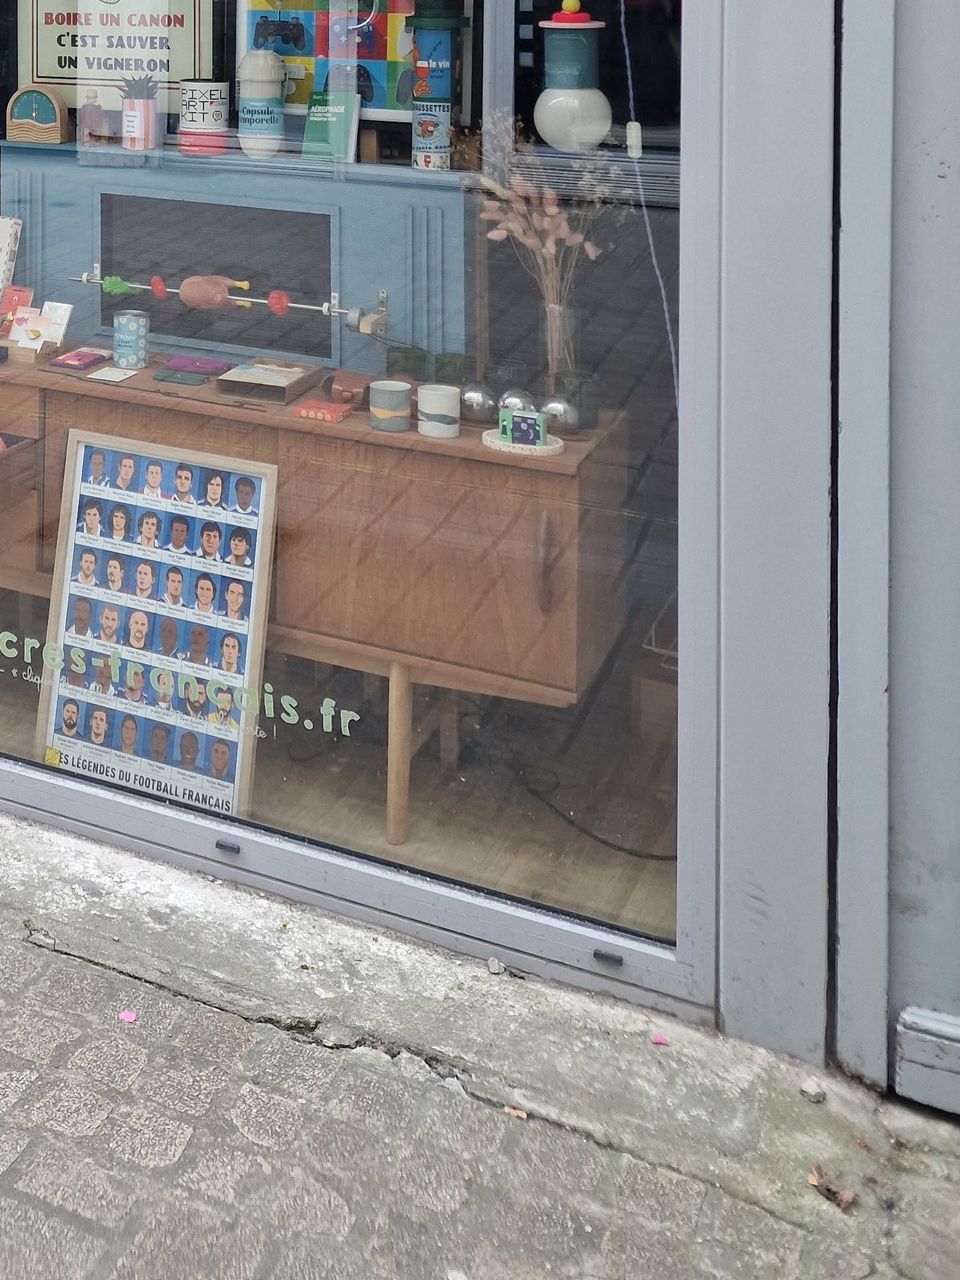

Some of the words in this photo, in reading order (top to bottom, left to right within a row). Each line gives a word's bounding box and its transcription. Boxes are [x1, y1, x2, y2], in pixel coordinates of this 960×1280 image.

[44, 12, 93, 26] BOIRE
[99, 13, 121, 27] UN
[127, 14, 185, 28] CANON
[56, 32, 99, 48] C'EST
[106, 35, 171, 50] SAUVER
[57, 56, 78, 69] UN
[84, 56, 170, 73] VIGNERON
[181, 88, 227, 100] PIXEL
[181, 100, 209, 111] ART
[240, 106, 275, 118] Capsule
[181, 111, 209, 122] KIT
[71, 752, 116, 778] LÉGENDES
[118, 771, 131, 783] DU
[133, 772, 180, 797] FOOTBALL
[182, 787, 231, 813] FRANÇAIS
